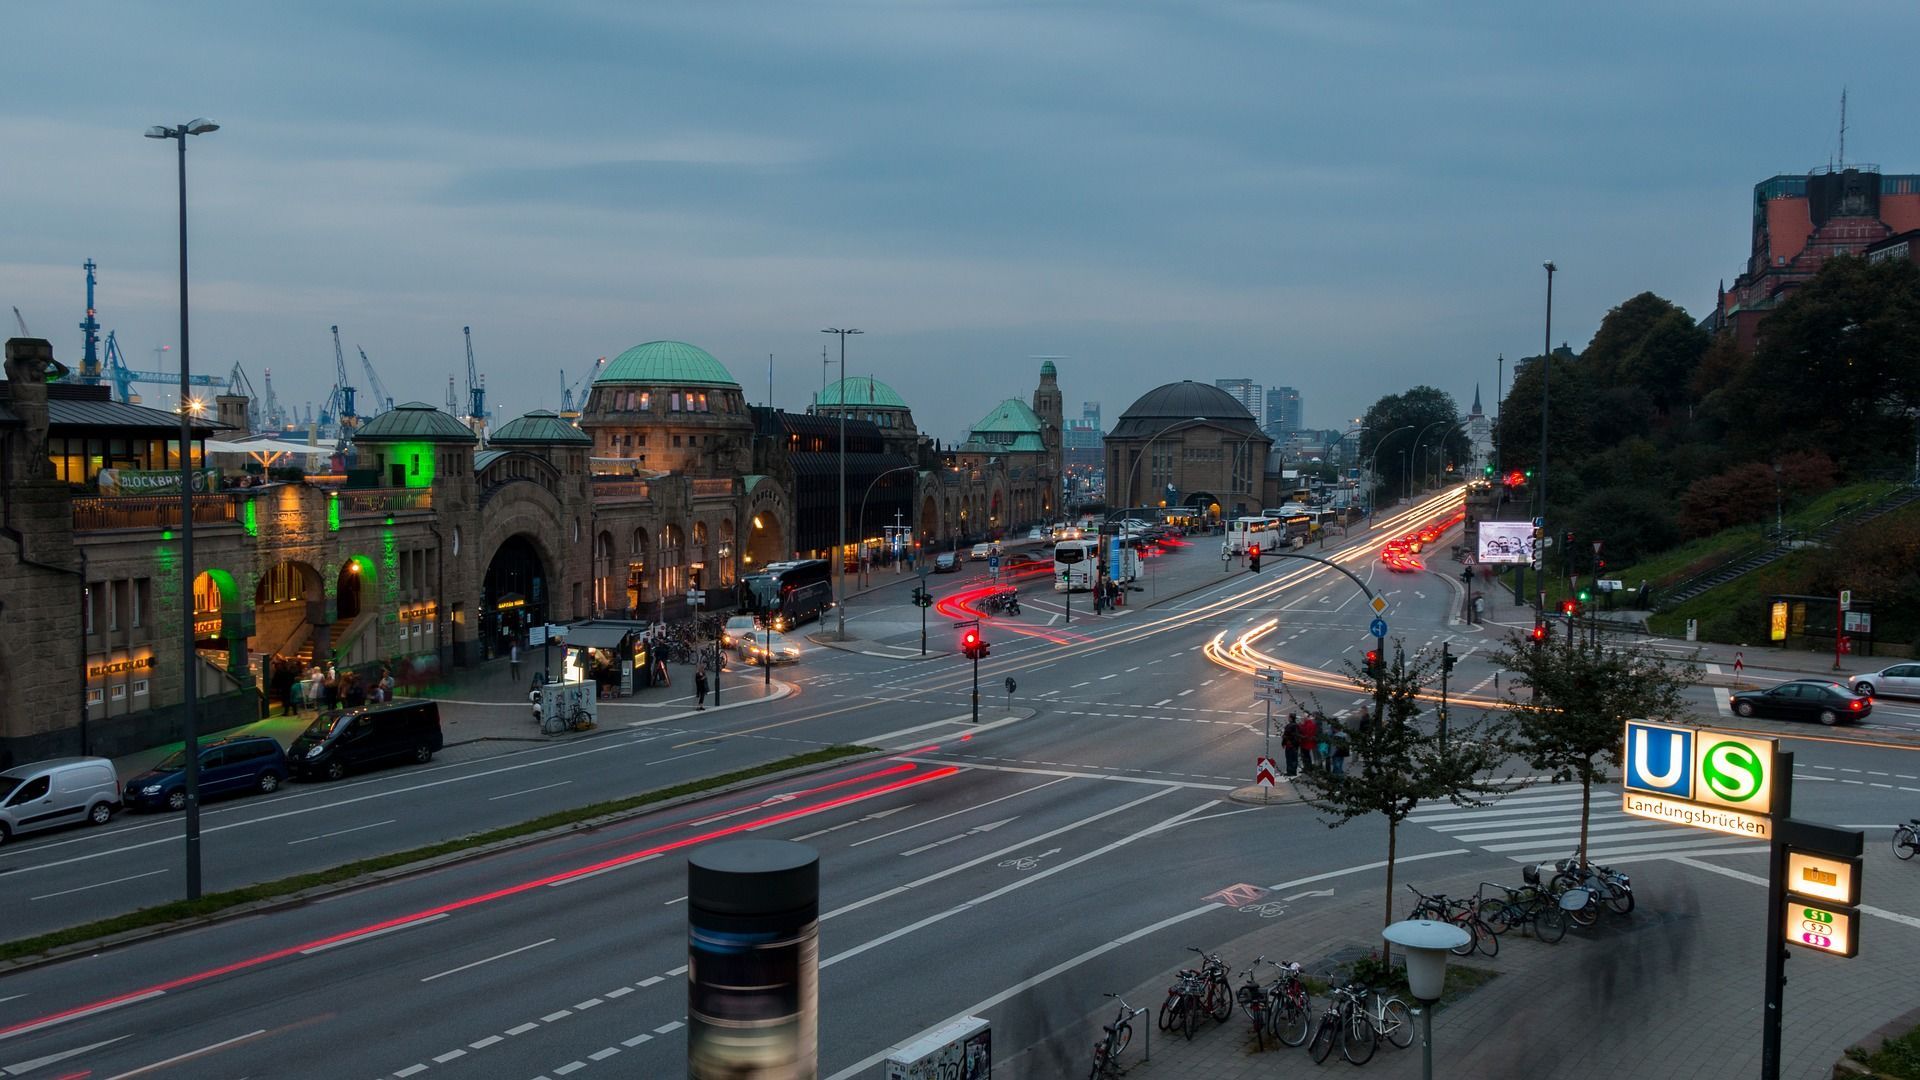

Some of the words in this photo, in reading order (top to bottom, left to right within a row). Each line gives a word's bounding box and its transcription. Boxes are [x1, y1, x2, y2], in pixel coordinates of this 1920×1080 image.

[1634, 728, 1683, 788] U
[1711, 745, 1755, 798] S
[1627, 796, 1766, 835] Landungsbrücken
[1811, 910, 1826, 922] S1
[1811, 923, 1824, 933] S2
